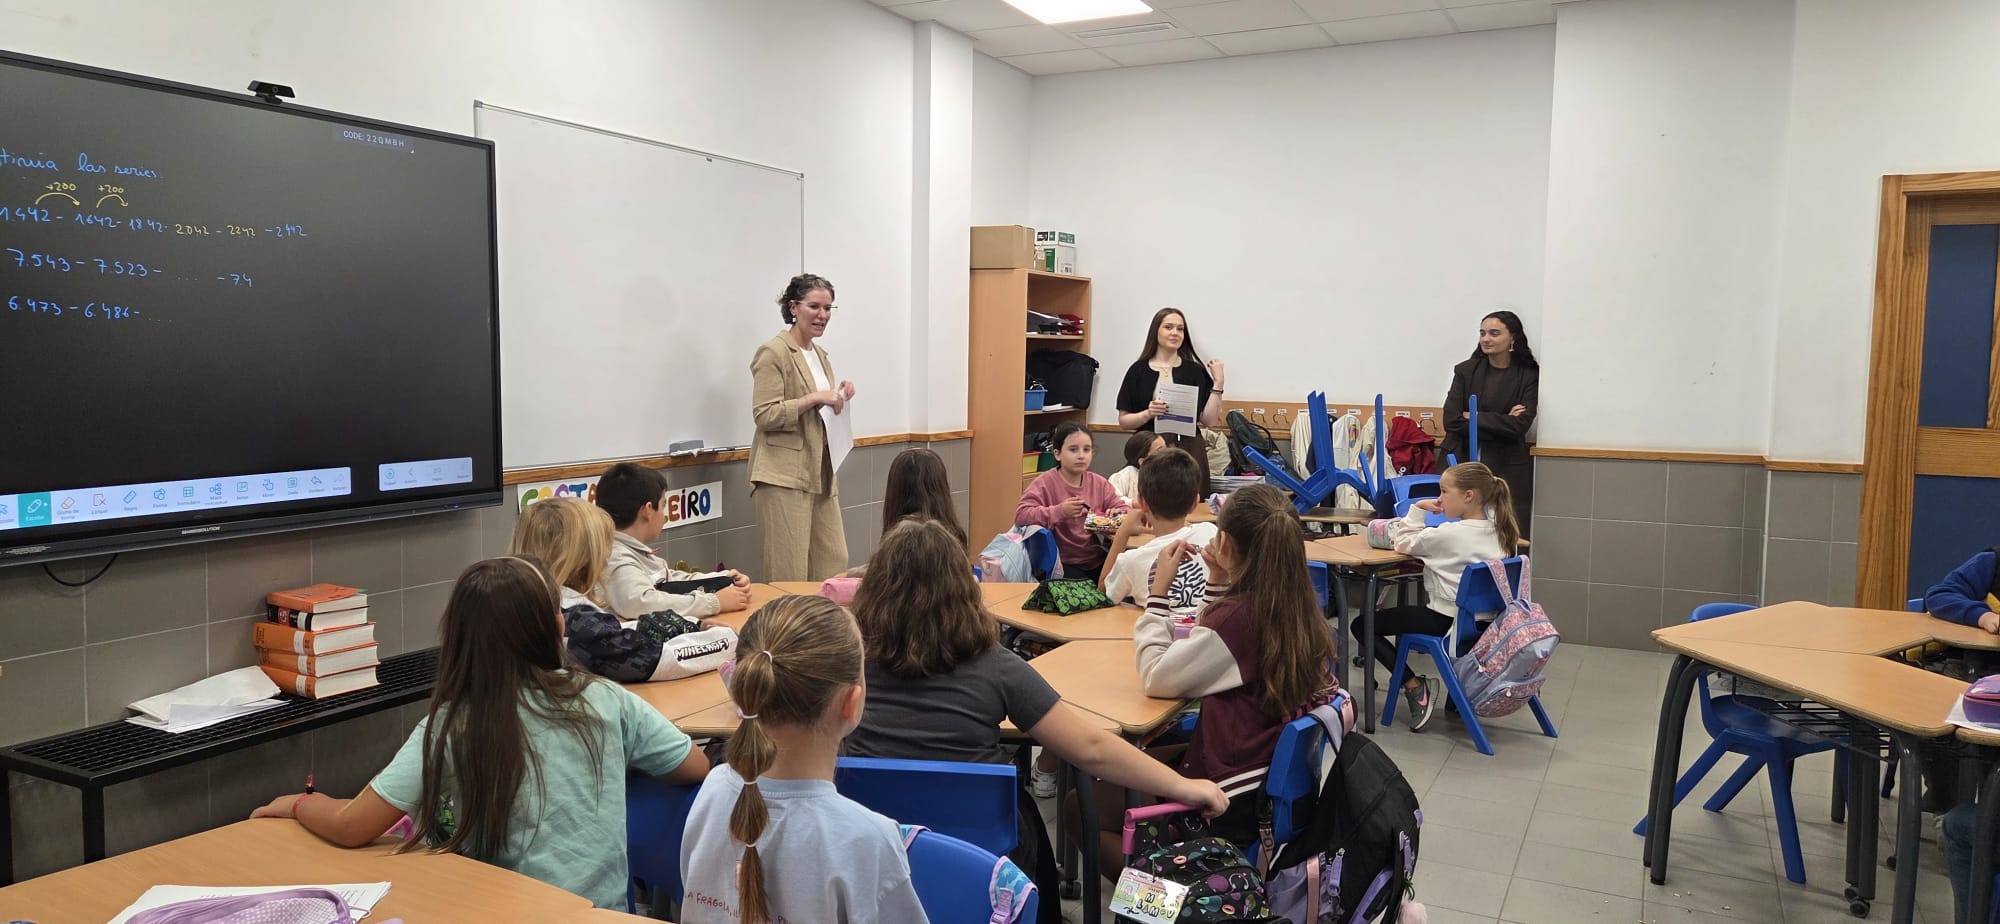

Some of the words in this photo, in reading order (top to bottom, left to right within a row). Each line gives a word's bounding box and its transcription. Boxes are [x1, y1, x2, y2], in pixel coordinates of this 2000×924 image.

[77, 153, 106, 173] las
[664, 488, 711, 523] EIRO
[673, 638, 729, 661] MINECRAFT
